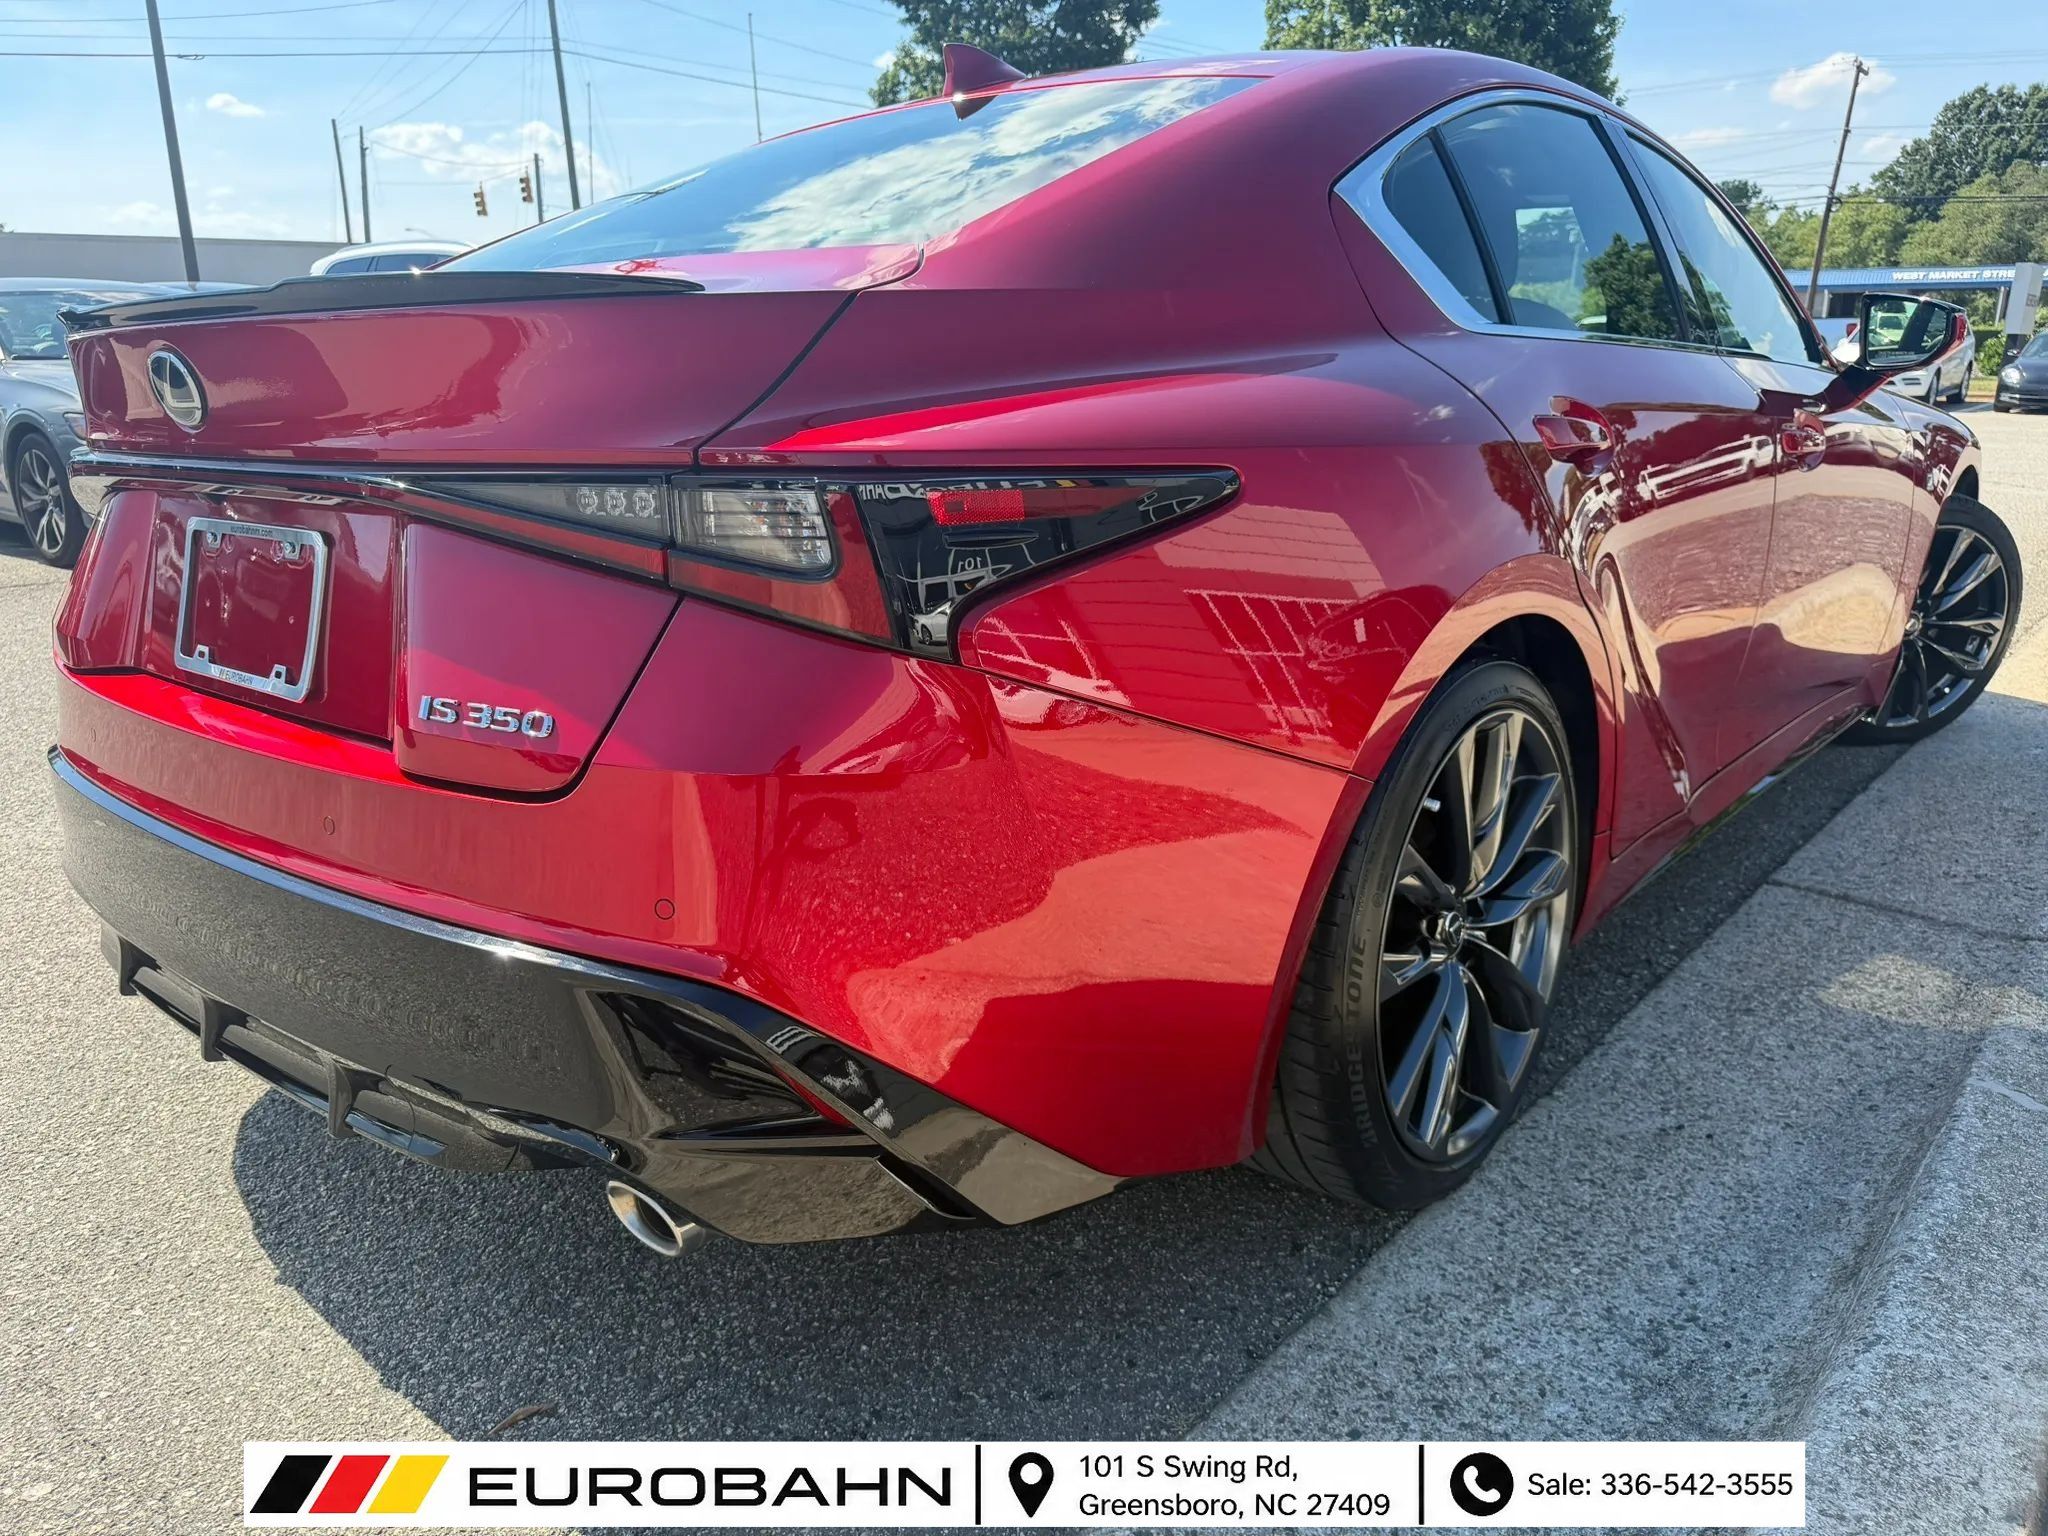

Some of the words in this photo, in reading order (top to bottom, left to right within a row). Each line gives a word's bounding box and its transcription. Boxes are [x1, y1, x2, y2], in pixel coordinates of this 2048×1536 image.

[1892, 271, 1927, 281] WEST
[1928, 270, 1979, 281] MARKET
[1982, 269, 2016, 279] STRE
[418, 695, 459, 724] IS
[462, 702, 554, 738] 350
